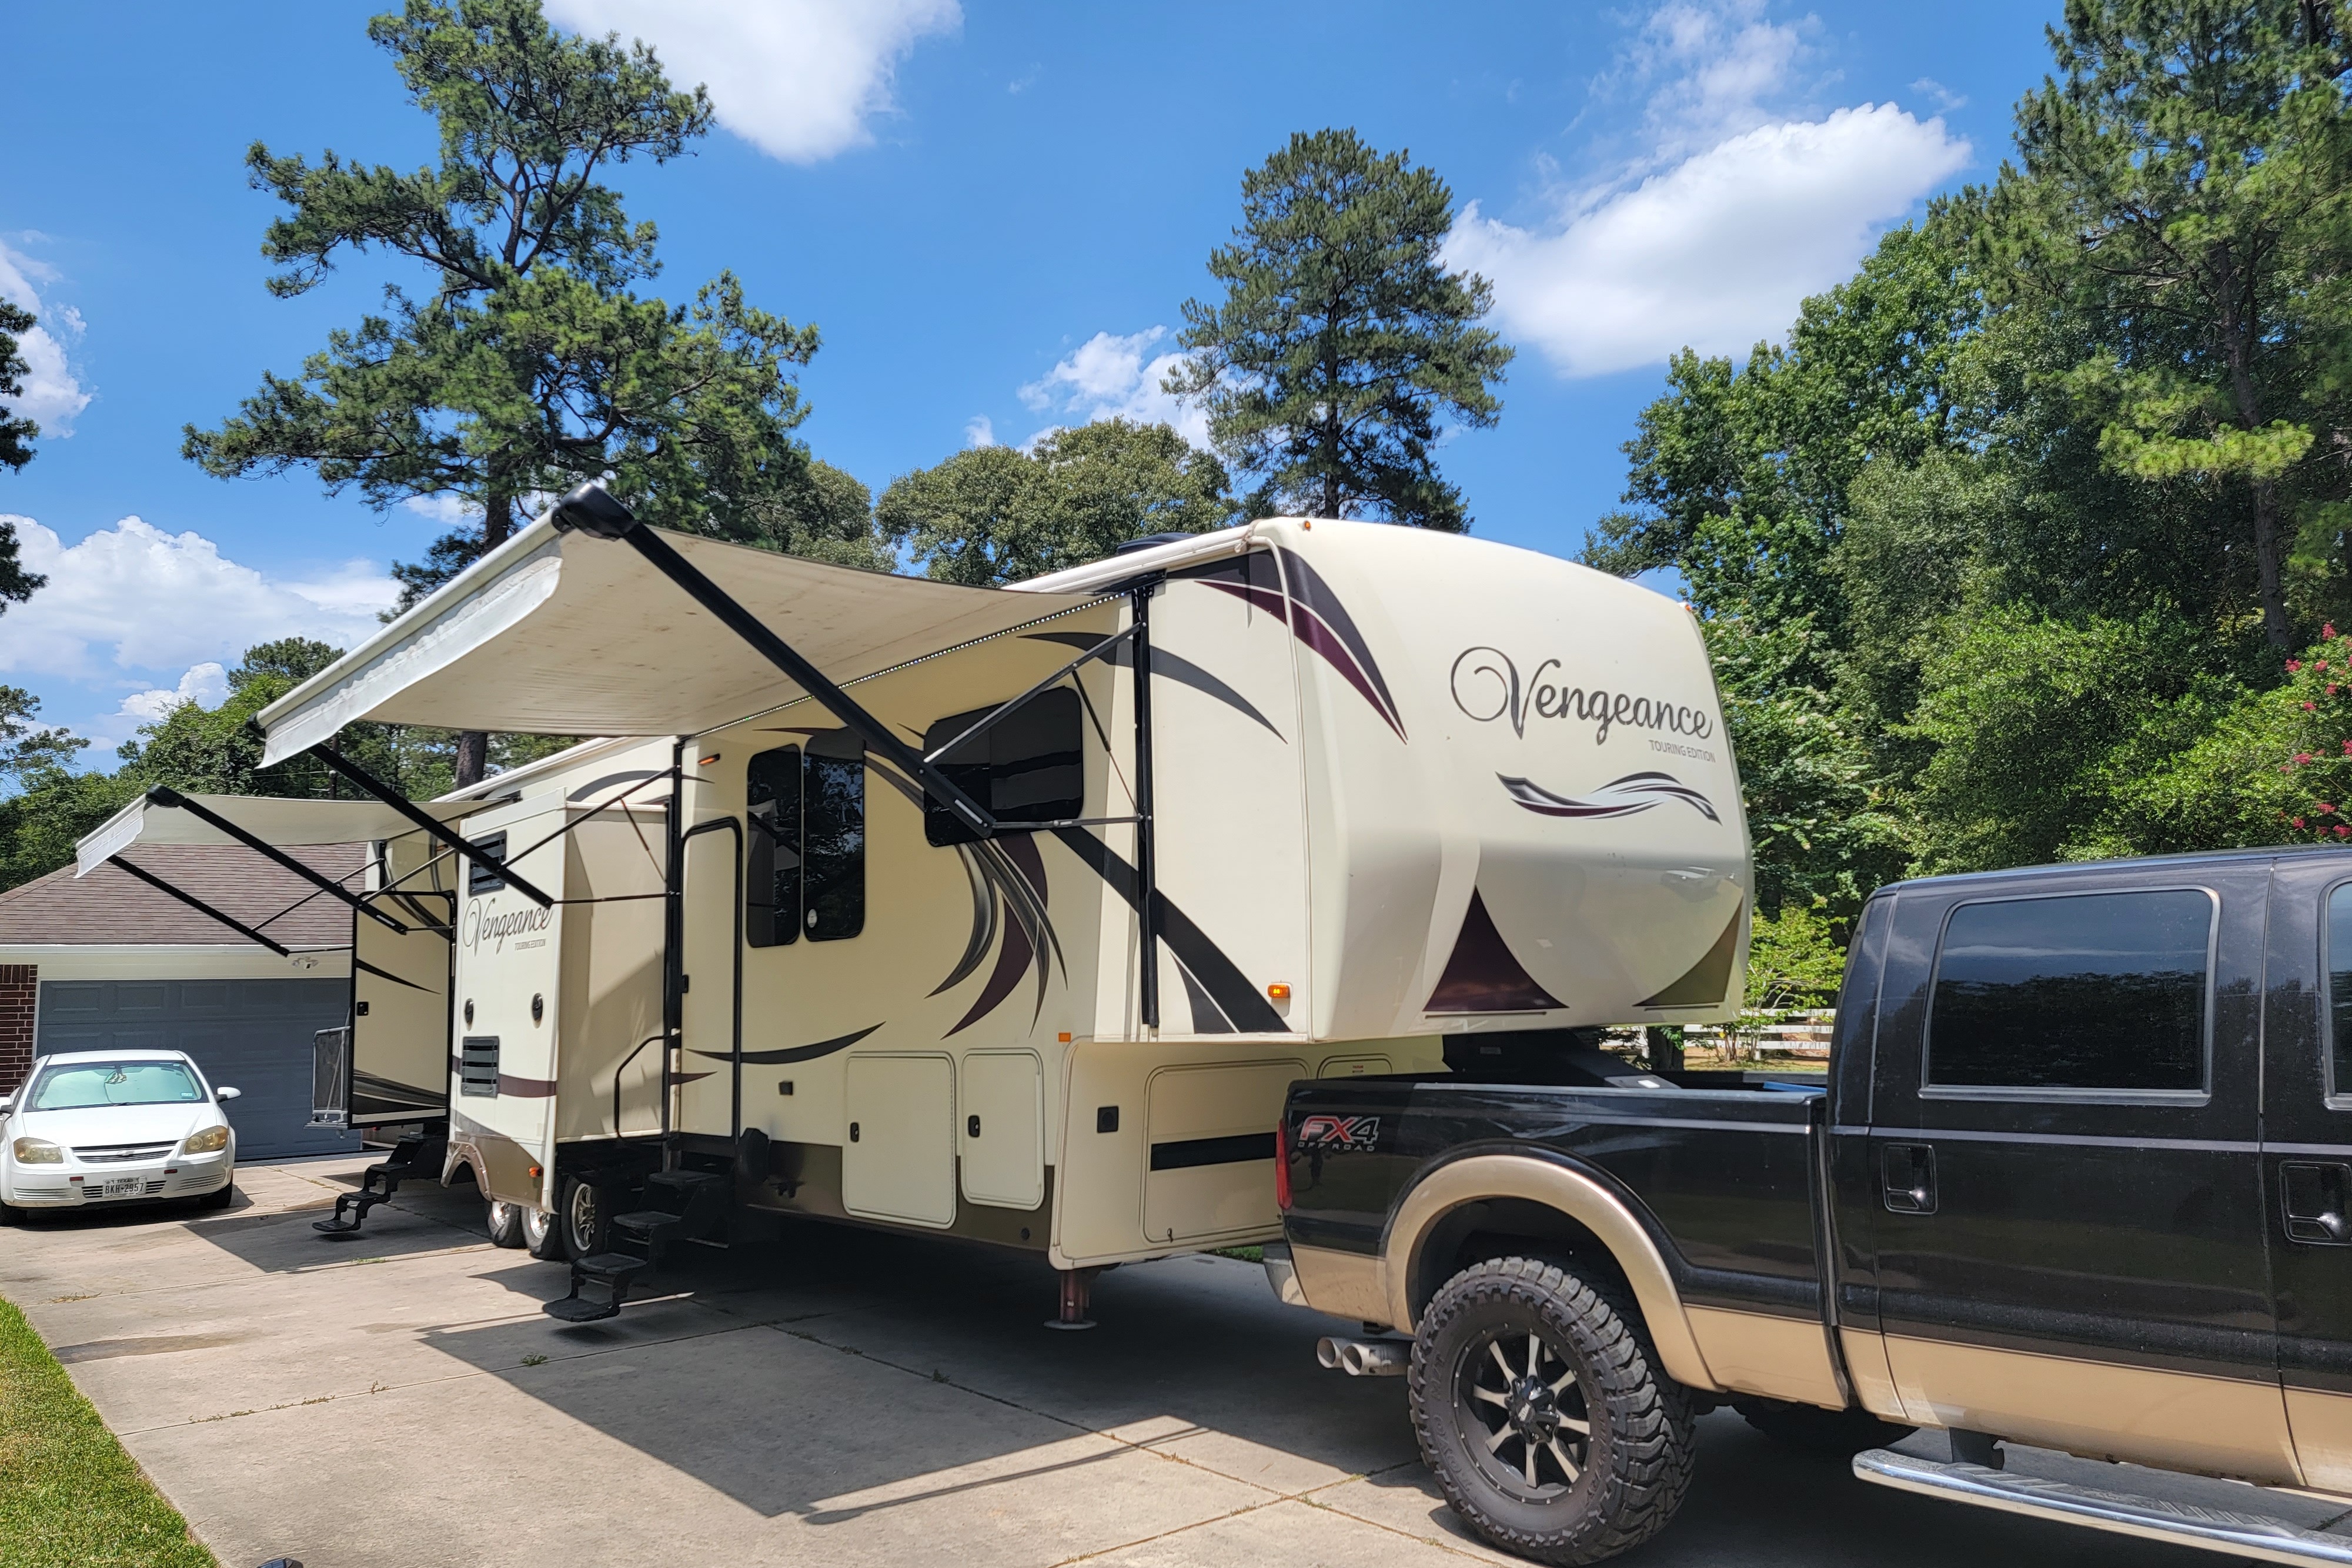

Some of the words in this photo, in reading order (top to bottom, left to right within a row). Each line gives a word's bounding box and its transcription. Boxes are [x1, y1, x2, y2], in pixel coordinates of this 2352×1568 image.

[1451, 646, 1713, 745] Vengeance
[1648, 740, 1686, 756] TOURING
[1686, 747, 1716, 763] EDITION
[462, 898, 553, 957] Vengeance
[1298, 1115, 1381, 1145] FX4
[1297, 1141, 1327, 1149] OFF
[1331, 1142, 1375, 1152] ROAD
